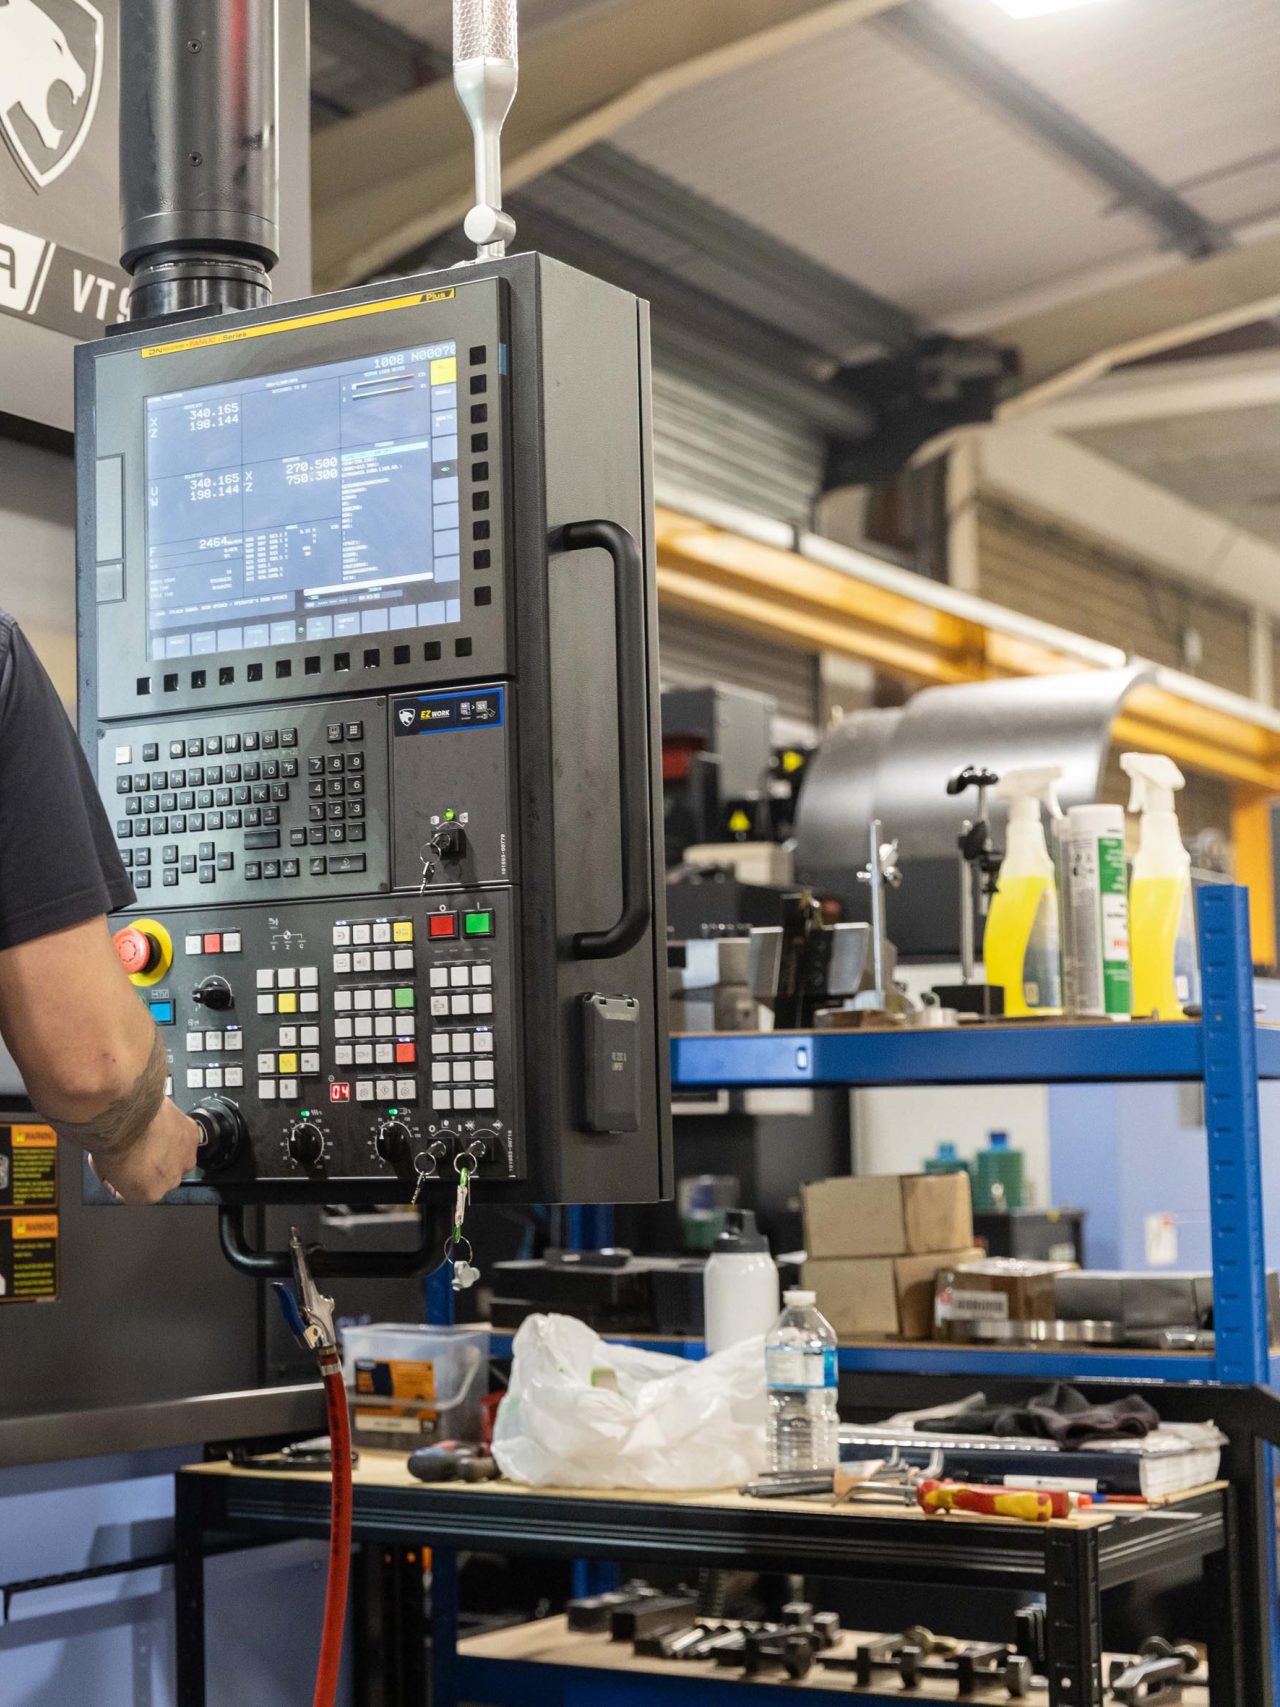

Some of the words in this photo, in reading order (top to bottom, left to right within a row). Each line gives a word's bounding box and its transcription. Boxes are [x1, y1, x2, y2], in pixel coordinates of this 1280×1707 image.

[426, 291, 446, 301] Plus
[223, 332, 247, 341] Series
[374, 354, 404, 369] 1008
[150, 417, 158, 427] X
[190, 403, 239, 420] 340.165
[150, 428, 158, 438] Z
[190, 414, 239, 431] 198.144
[245, 471, 253, 481] X
[285, 457, 338, 475] 270.500
[150, 486, 159, 496] U
[190, 473, 240, 490] 340.165
[245, 482, 253, 492] Z
[286, 468, 338, 486] 750.300
[190, 484, 239, 501] 198.144
[149, 546, 157, 557] F
[200, 536, 228, 549] 2464
[420, 710, 431, 719] EZ
[431, 709, 450, 717] WORK
[332, 1085, 350, 1099] 04
[26, 1222, 55, 1232] WARNING
